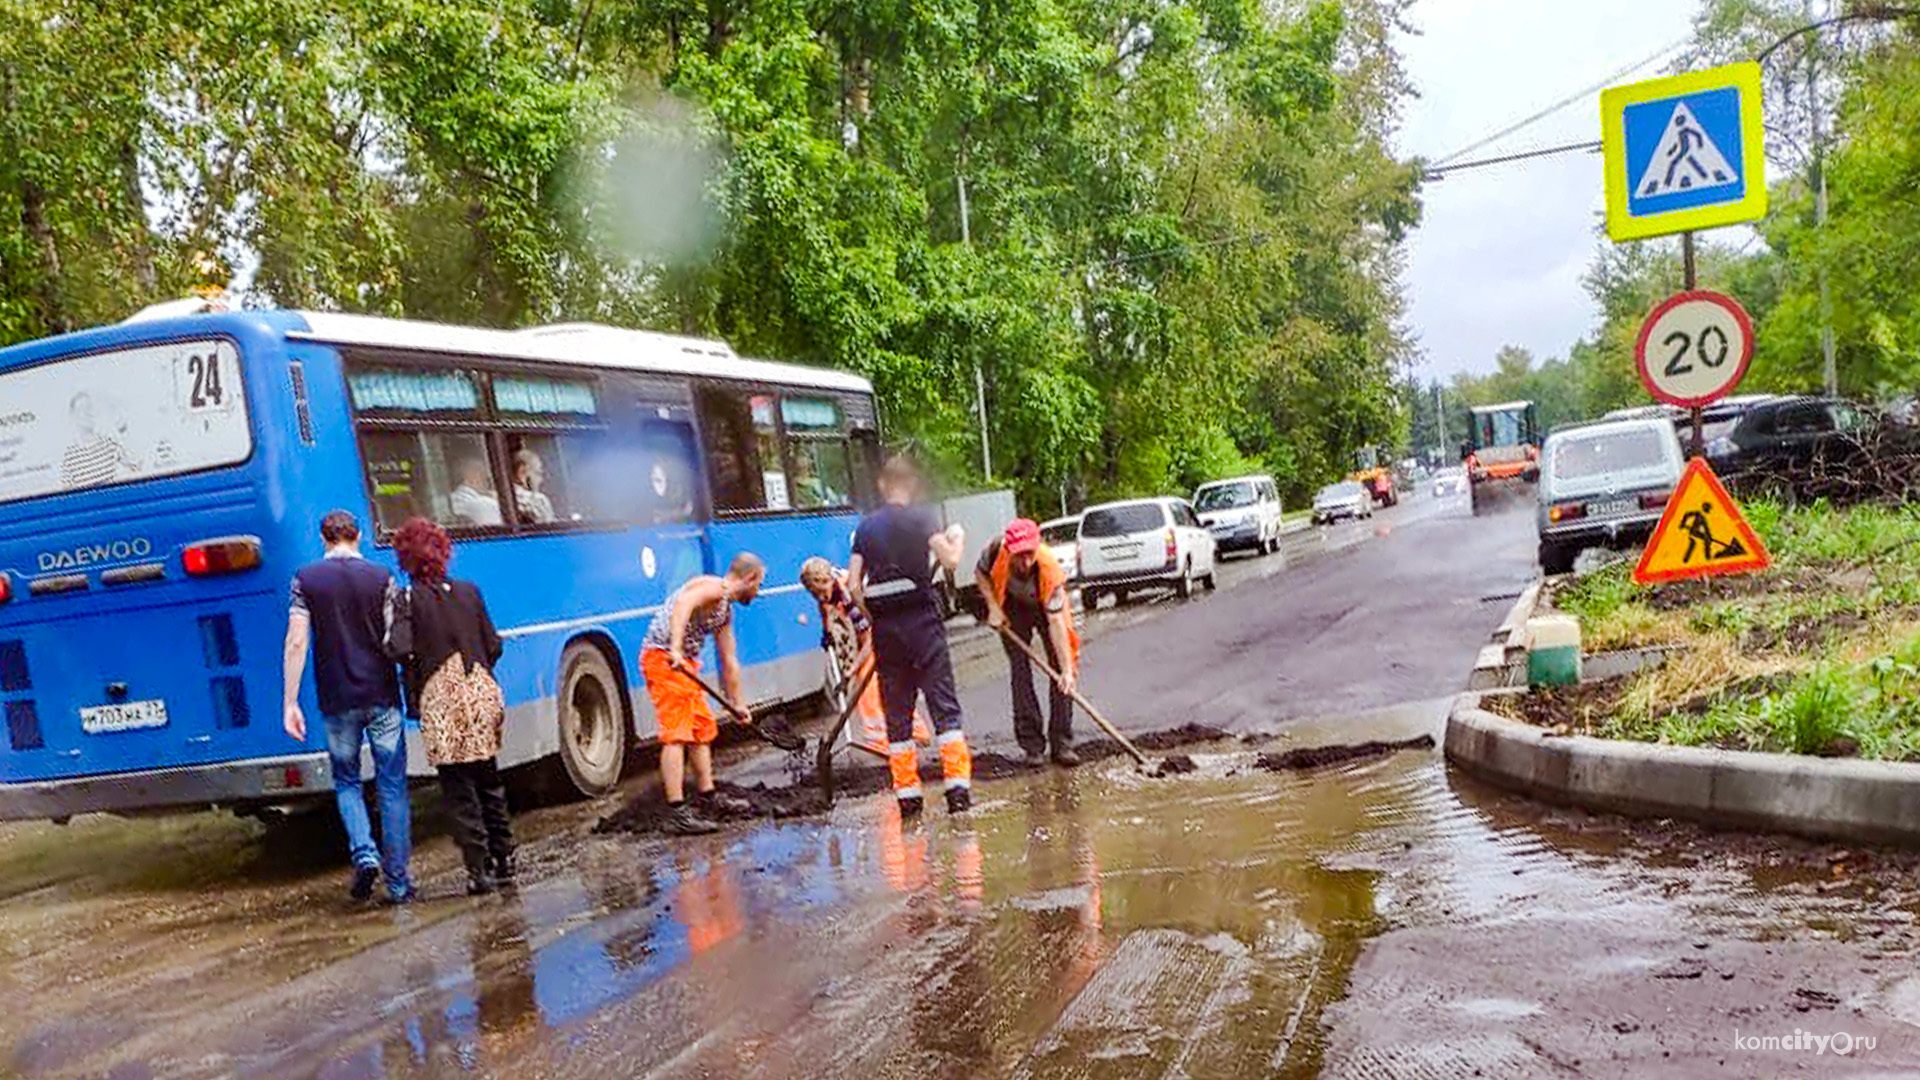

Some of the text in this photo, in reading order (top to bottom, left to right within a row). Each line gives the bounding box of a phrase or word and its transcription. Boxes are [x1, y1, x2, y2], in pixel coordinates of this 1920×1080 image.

[1663, 326, 1728, 377] 20
[189, 354, 222, 407] 24
[37, 538, 151, 570] DAEWOO
